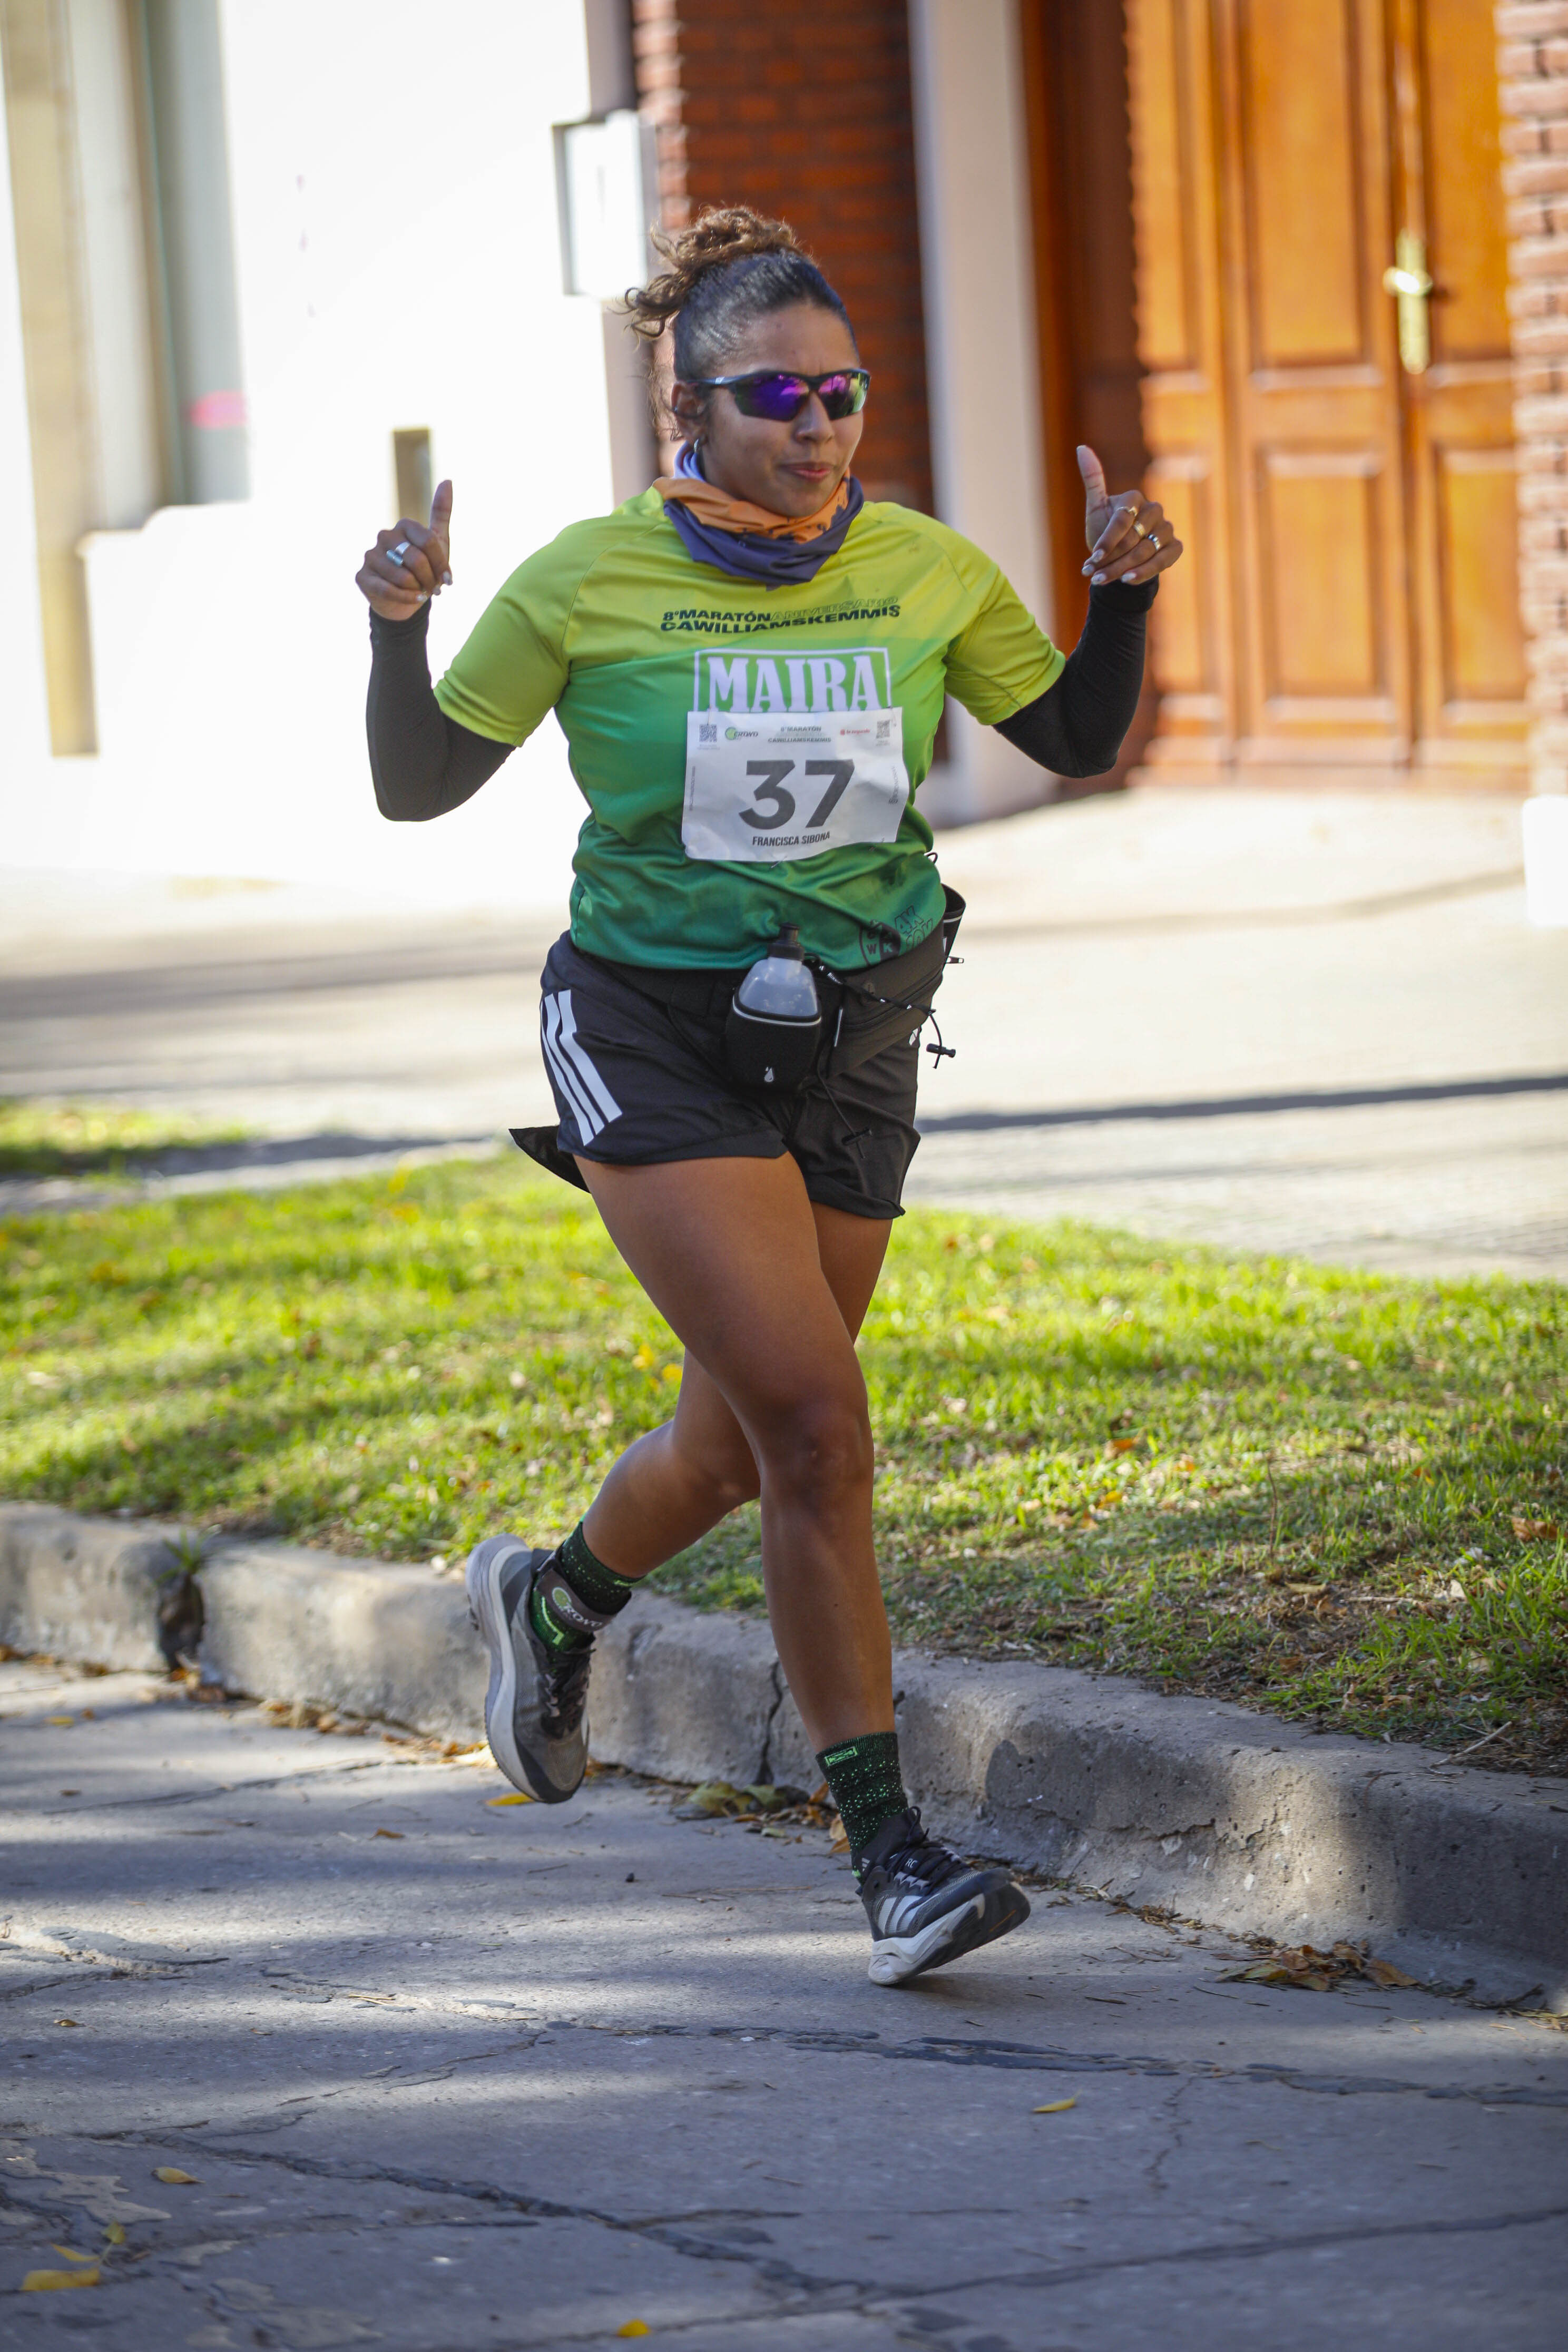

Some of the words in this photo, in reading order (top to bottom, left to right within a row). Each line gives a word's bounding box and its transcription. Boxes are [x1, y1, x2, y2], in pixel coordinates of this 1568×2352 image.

[660, 603, 900, 633] CAWILLIAMSKEMMIS
[707, 655, 883, 712] MAIRA
[739, 759, 855, 830] 37
[752, 836, 799, 846] FRANCISCA
[801, 830, 830, 844] SIBONA
